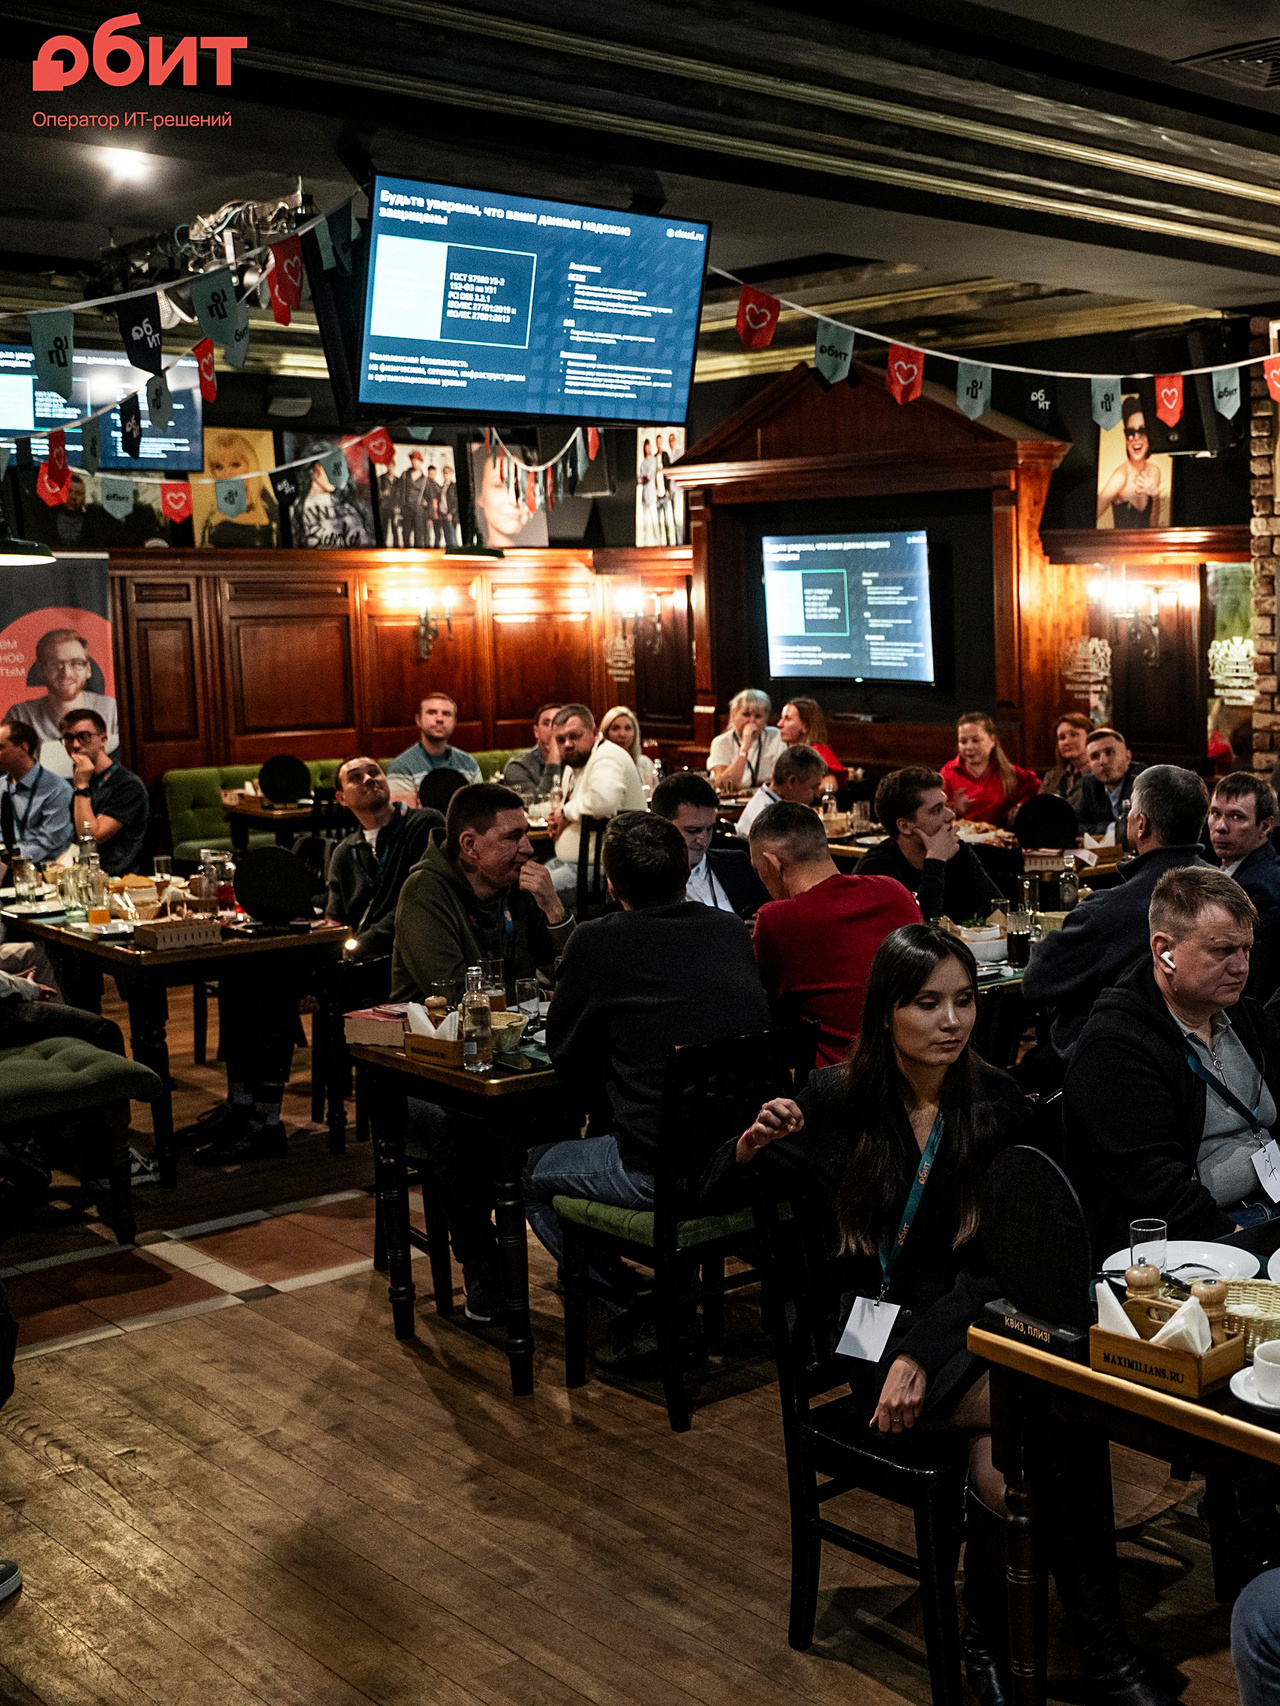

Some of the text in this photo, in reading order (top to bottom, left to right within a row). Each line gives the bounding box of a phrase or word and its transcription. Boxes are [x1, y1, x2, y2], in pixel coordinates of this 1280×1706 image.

[380, 190, 424, 207] Будьте
[484, 207, 504, 218] что
[1004, 1315, 1050, 1344] КВИЗ, ПЛИЗ!
[1103, 1351, 1185, 1384] MAXIMILIANS.RU
